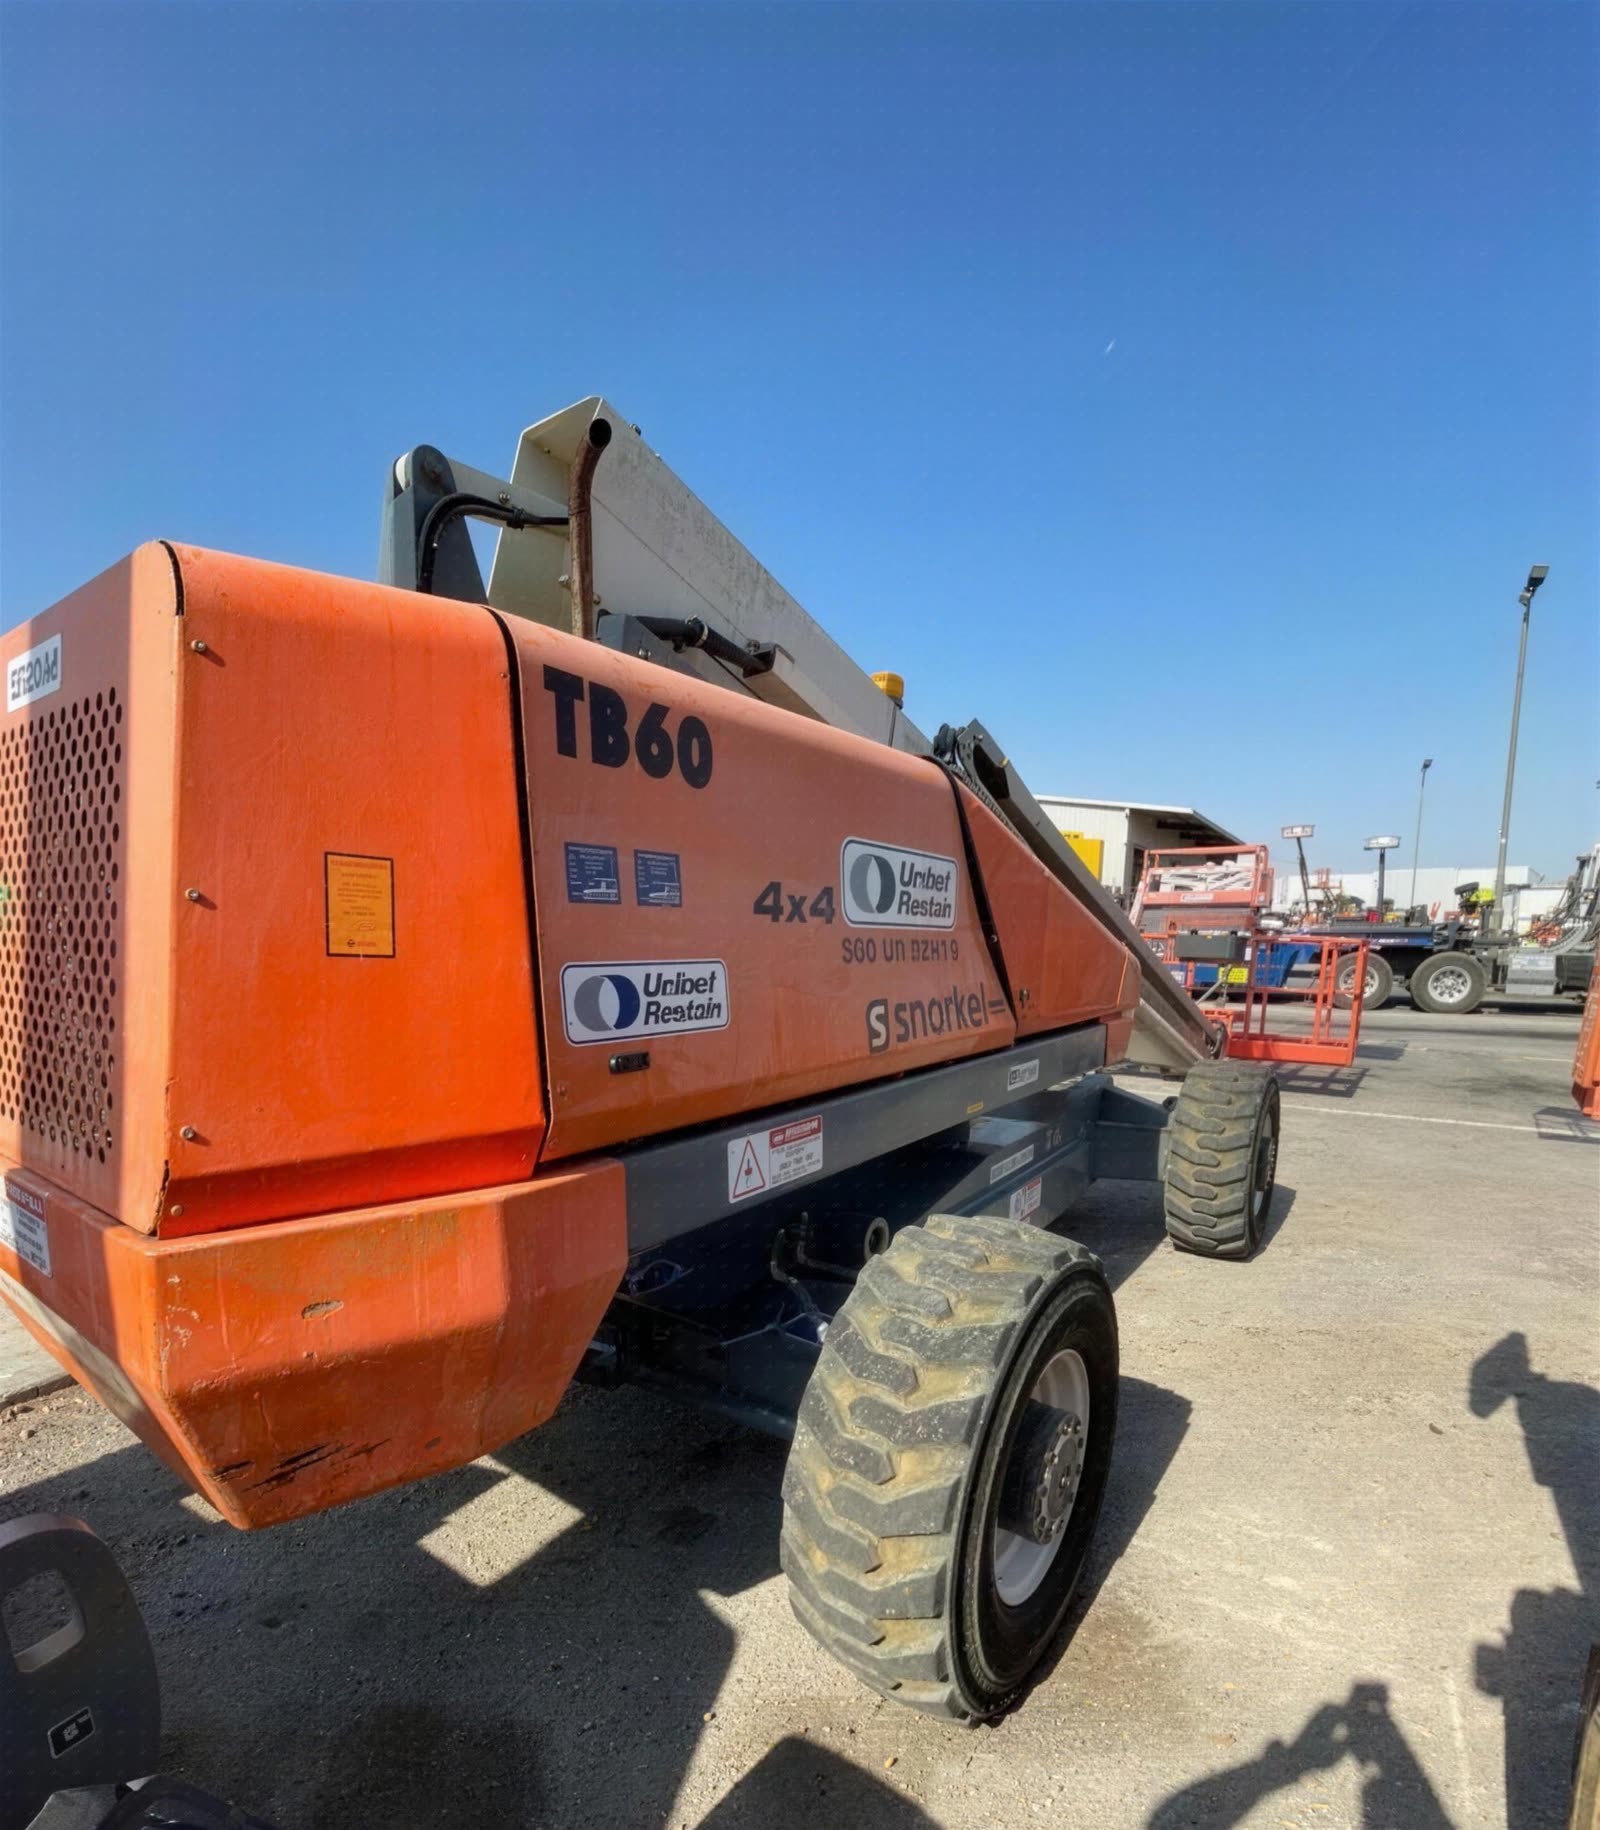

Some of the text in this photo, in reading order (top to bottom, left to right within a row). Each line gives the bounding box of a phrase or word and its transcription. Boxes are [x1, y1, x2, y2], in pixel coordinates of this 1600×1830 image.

[543, 664, 713, 789] TB60
[753, 881, 835, 924] 4x4
[894, 981, 989, 1043] snorkel
